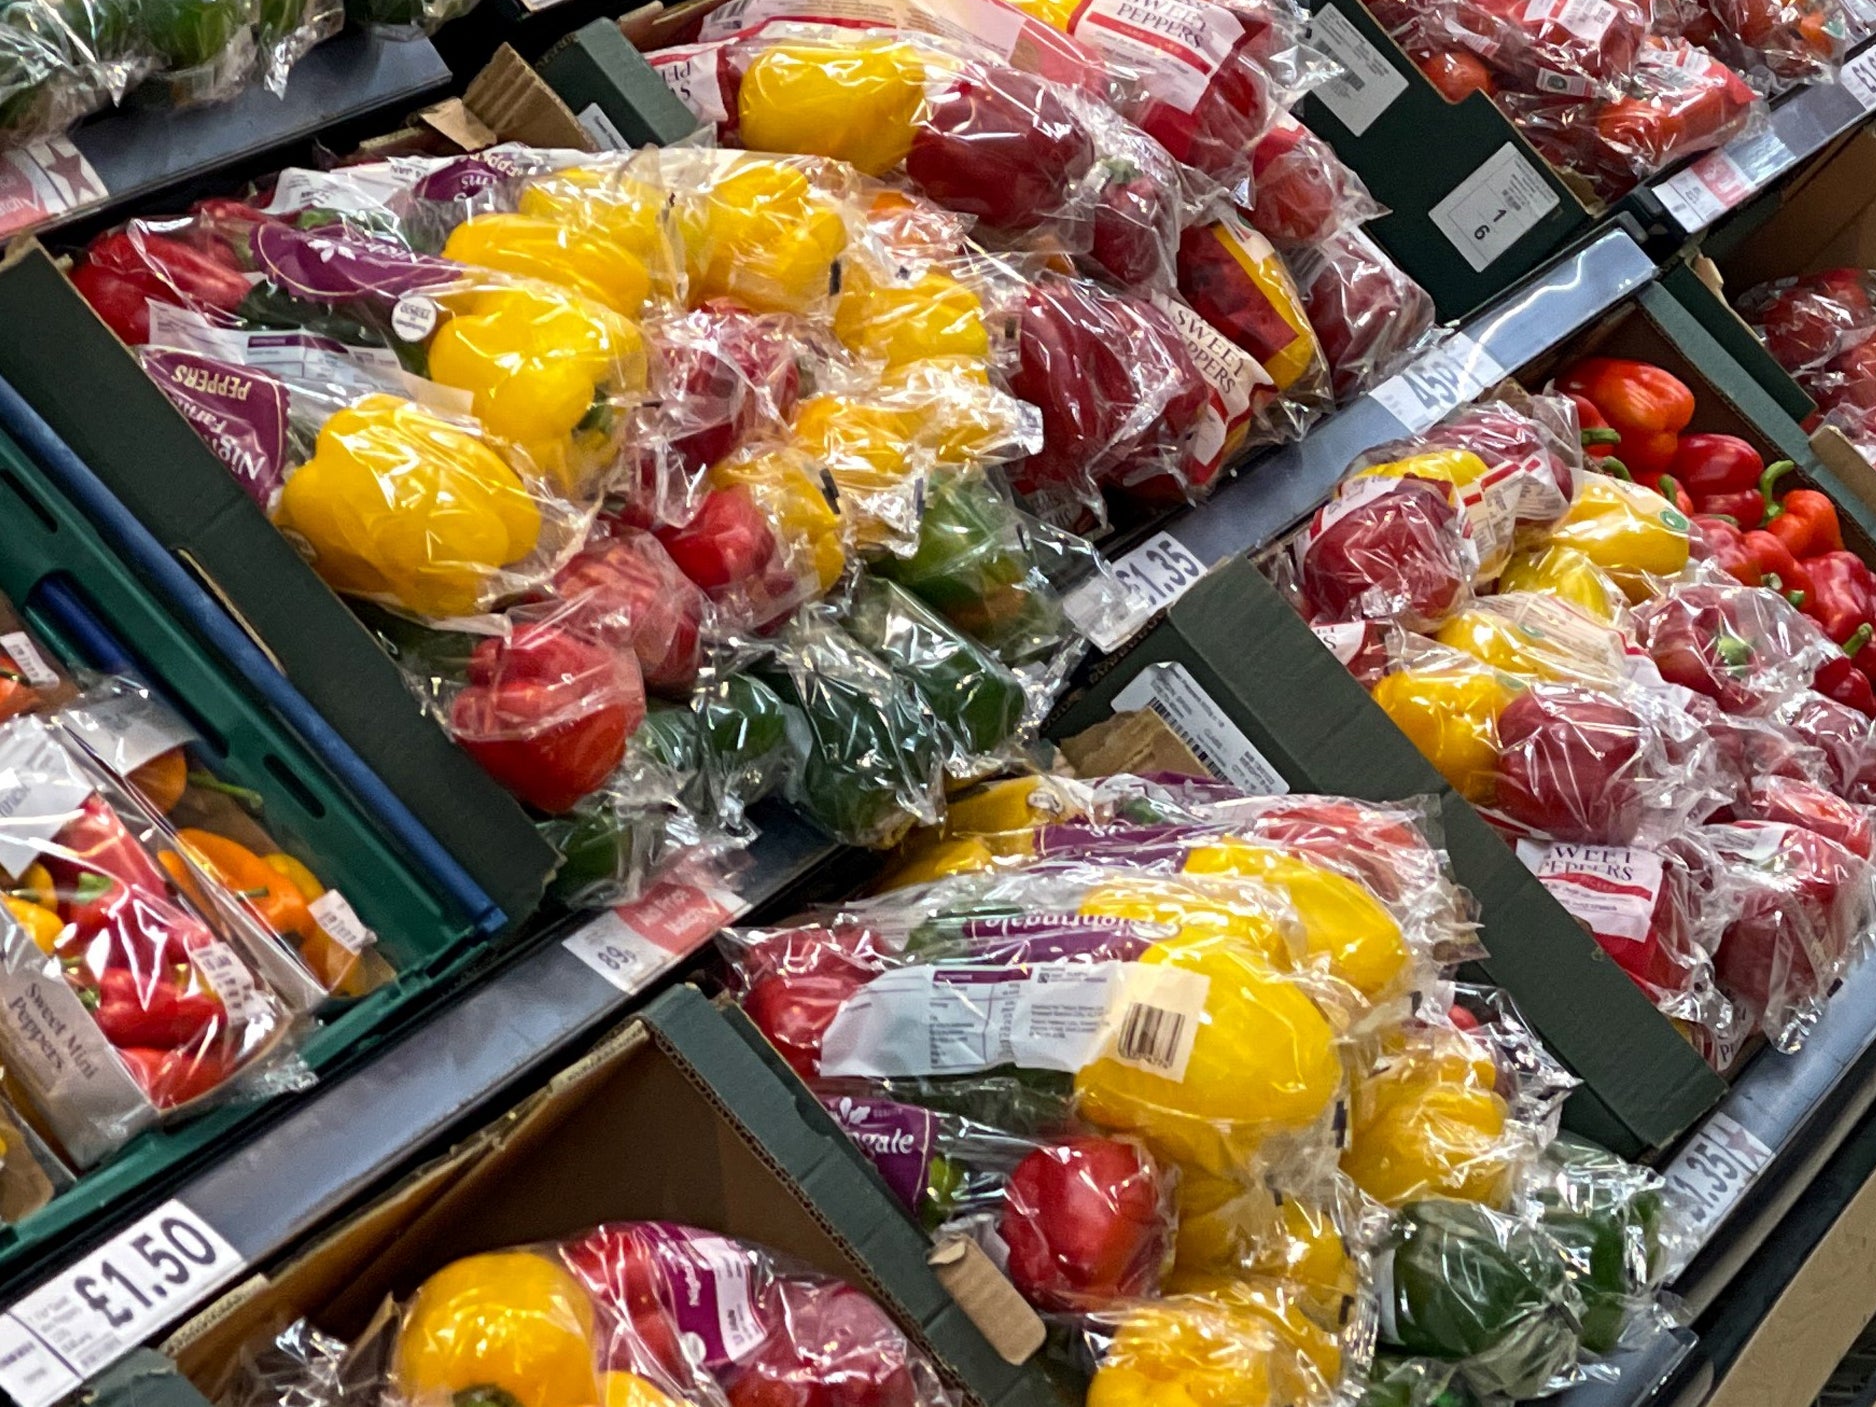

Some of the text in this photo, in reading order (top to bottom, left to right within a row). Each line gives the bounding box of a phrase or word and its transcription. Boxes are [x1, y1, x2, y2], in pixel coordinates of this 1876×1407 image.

[1474, 224, 1490, 240] 6
[1493, 209, 1507, 223] 1
[1173, 309, 1244, 379] SWEET
[170, 363, 252, 402] PEPPERS
[9, 995, 66, 1070] Peppers
[25, 982, 95, 1079] Sweet Mini
[73, 1216, 217, 1328] £1.50
